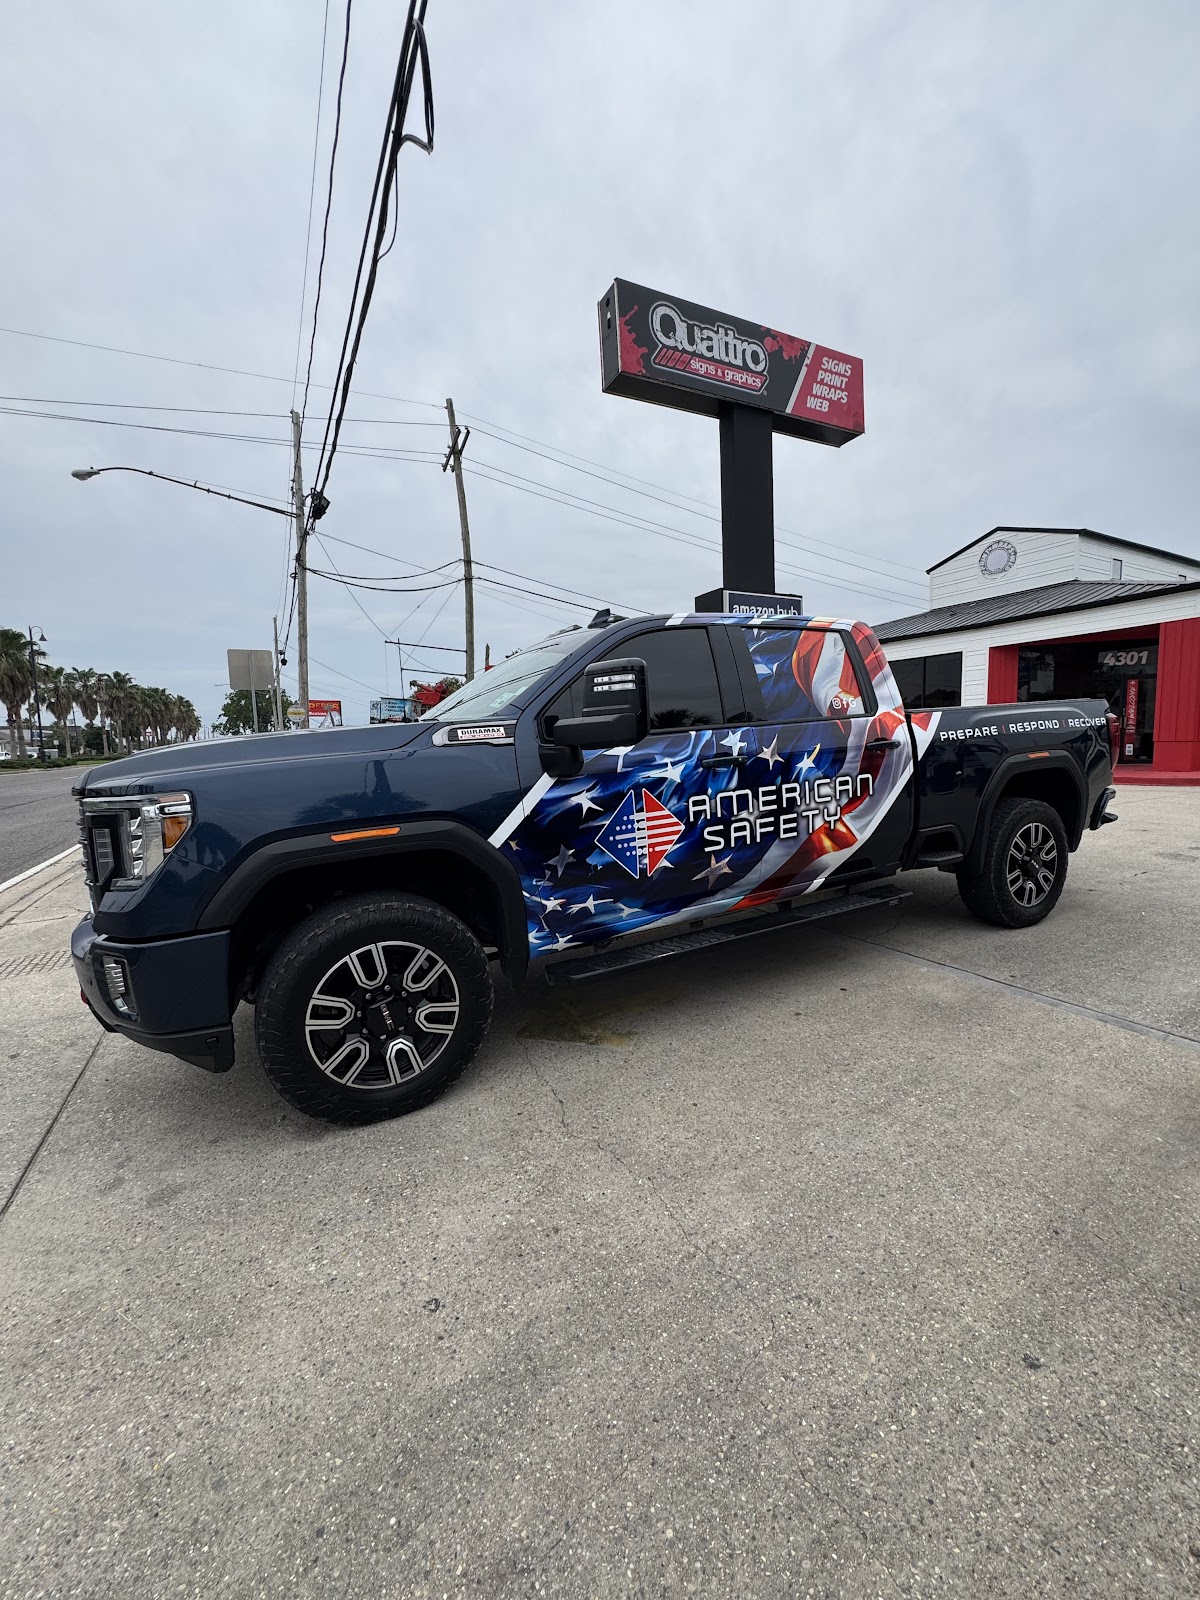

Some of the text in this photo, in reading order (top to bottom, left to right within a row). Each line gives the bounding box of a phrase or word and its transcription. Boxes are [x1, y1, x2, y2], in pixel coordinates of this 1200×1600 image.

[653, 306, 766, 372] Quattro
[690, 358, 716, 374] signs
[724, 369, 761, 387] graphics
[821, 356, 852, 376] SIGNS
[817, 370, 848, 389] PRINT
[806, 395, 830, 412] WEB
[812, 382, 848, 404] WRAPS
[733, 603, 798, 616] amazon hub
[1103, 650, 1149, 666] 4301
[461, 727, 502, 735] DURAMAX
[939, 717, 1107, 742] PREPARE RESPOND RECOVER
[688, 773, 873, 823] AMERICAN
[703, 806, 841, 852] SAFETY
